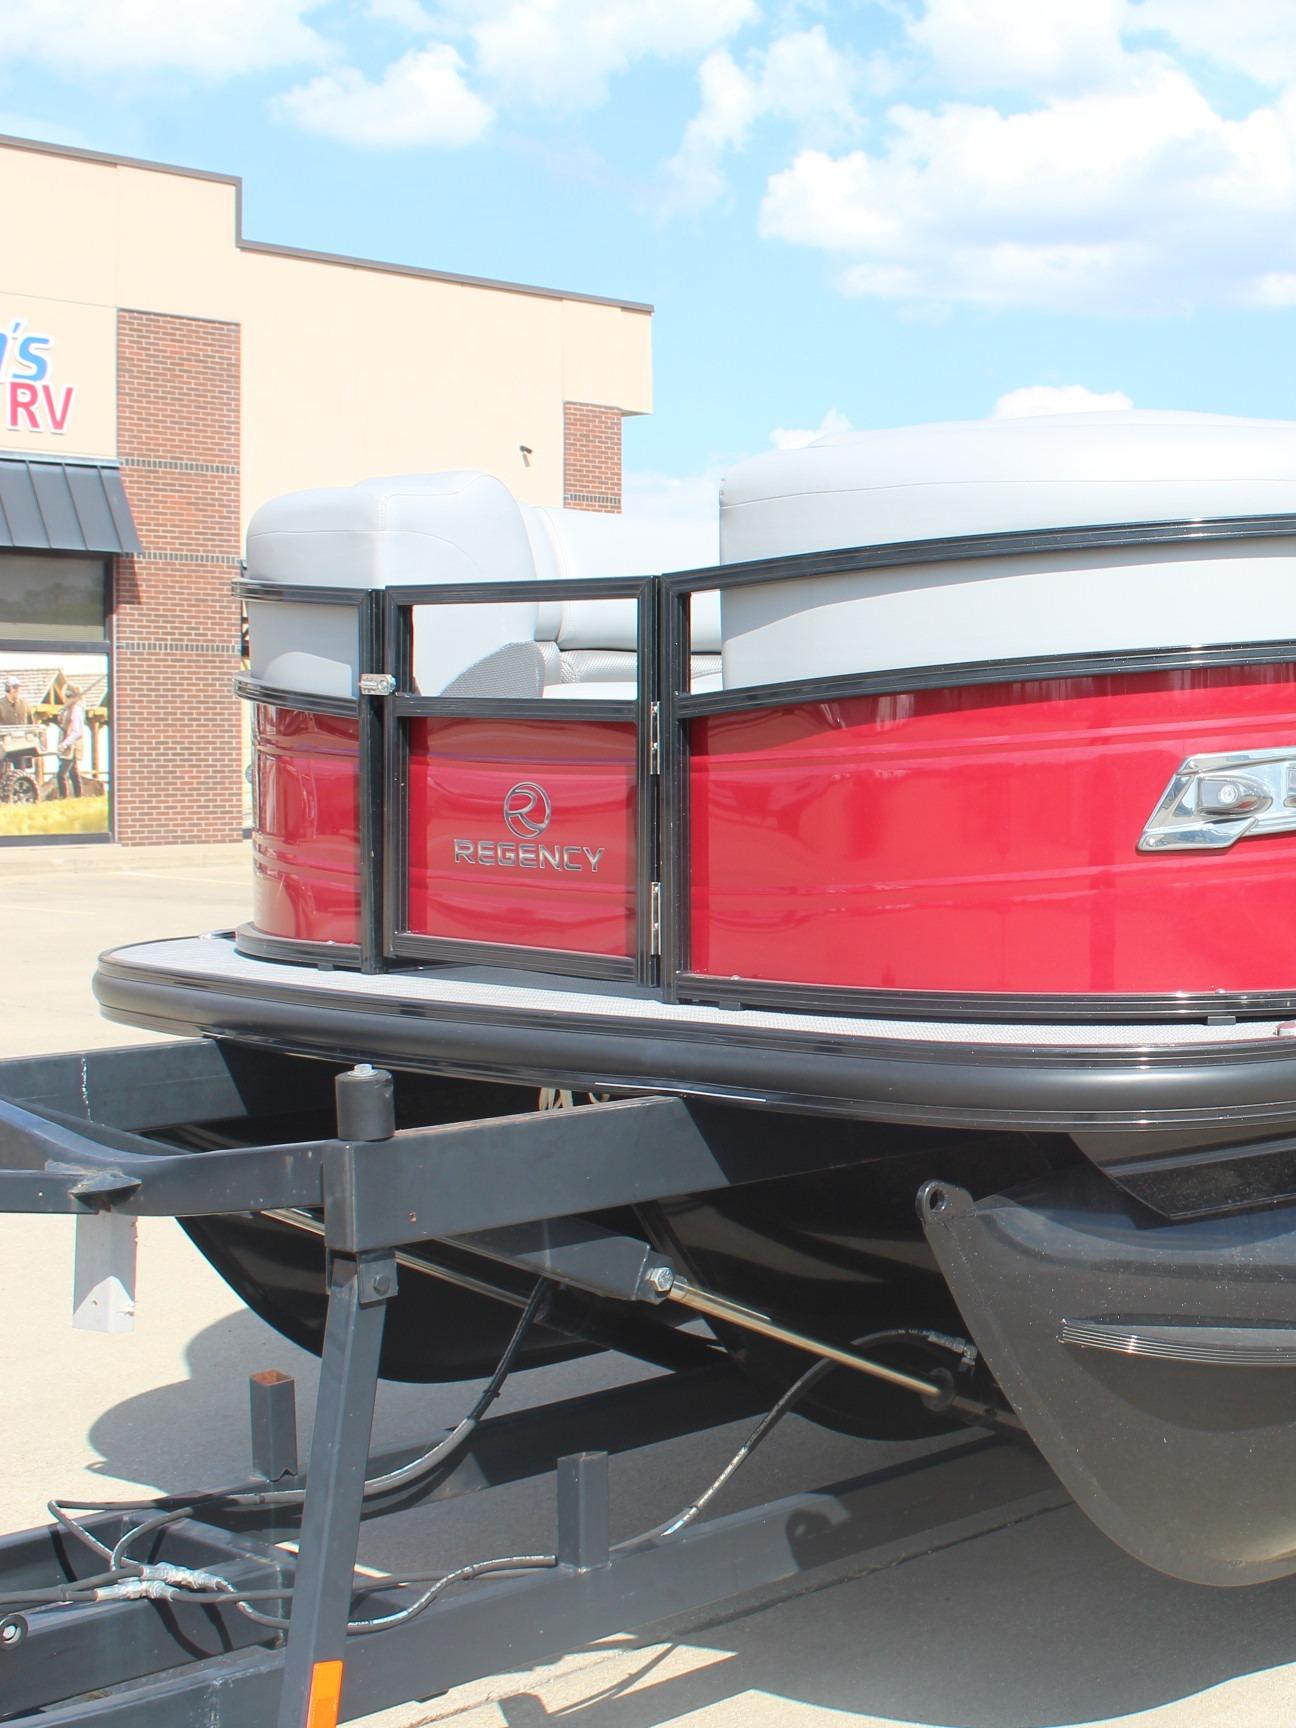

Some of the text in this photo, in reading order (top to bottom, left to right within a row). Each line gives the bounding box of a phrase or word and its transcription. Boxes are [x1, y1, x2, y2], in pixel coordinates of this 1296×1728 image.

[0, 322, 50, 383] 's
[9, 381, 74, 431] RV
[453, 839, 605, 873] REGENCY
